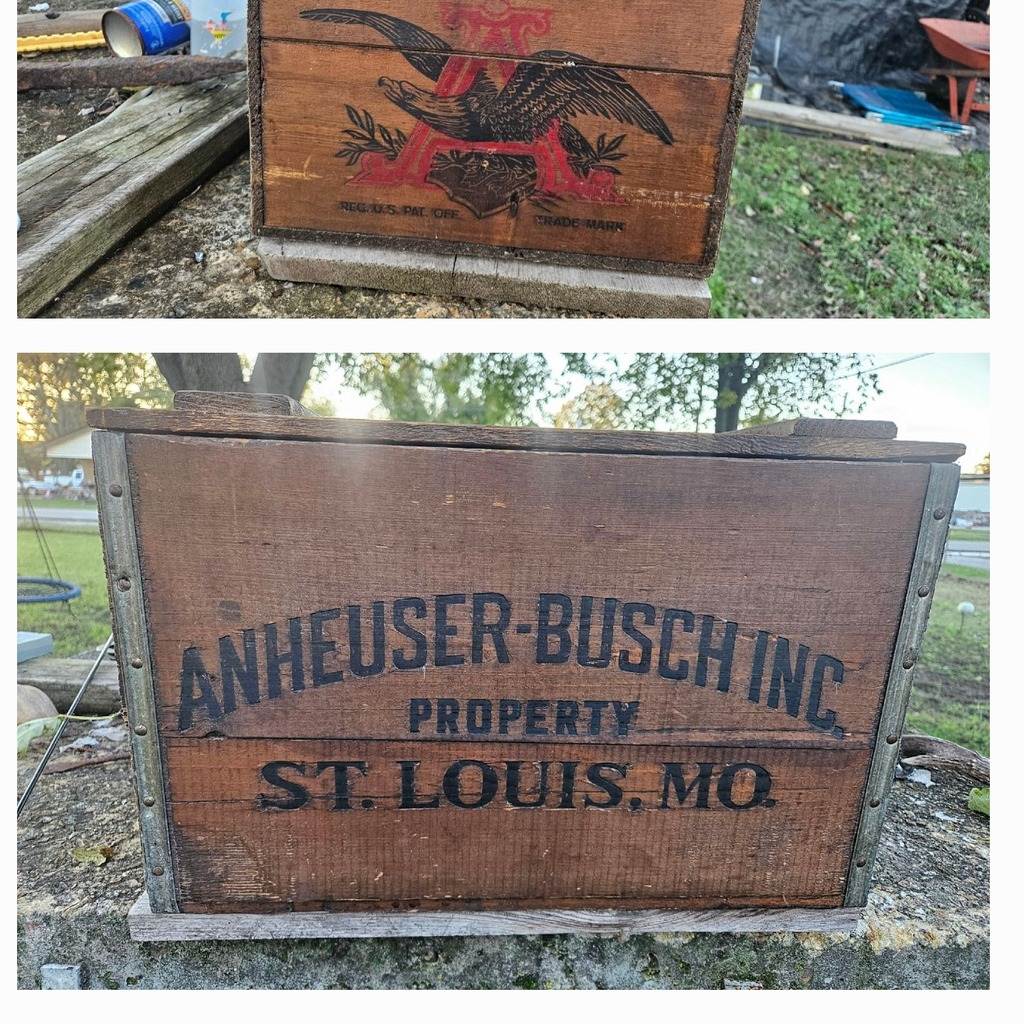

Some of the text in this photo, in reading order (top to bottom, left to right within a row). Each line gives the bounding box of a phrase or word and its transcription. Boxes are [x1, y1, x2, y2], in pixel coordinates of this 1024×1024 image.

[536, 214, 625, 232] TRADE MARK
[178, 592, 739, 733] ANHEUSER-BUSCH
[409, 698, 640, 738] PROPERTY
[260, 760, 373, 810] ST.
[659, 761, 776, 810] MO.
